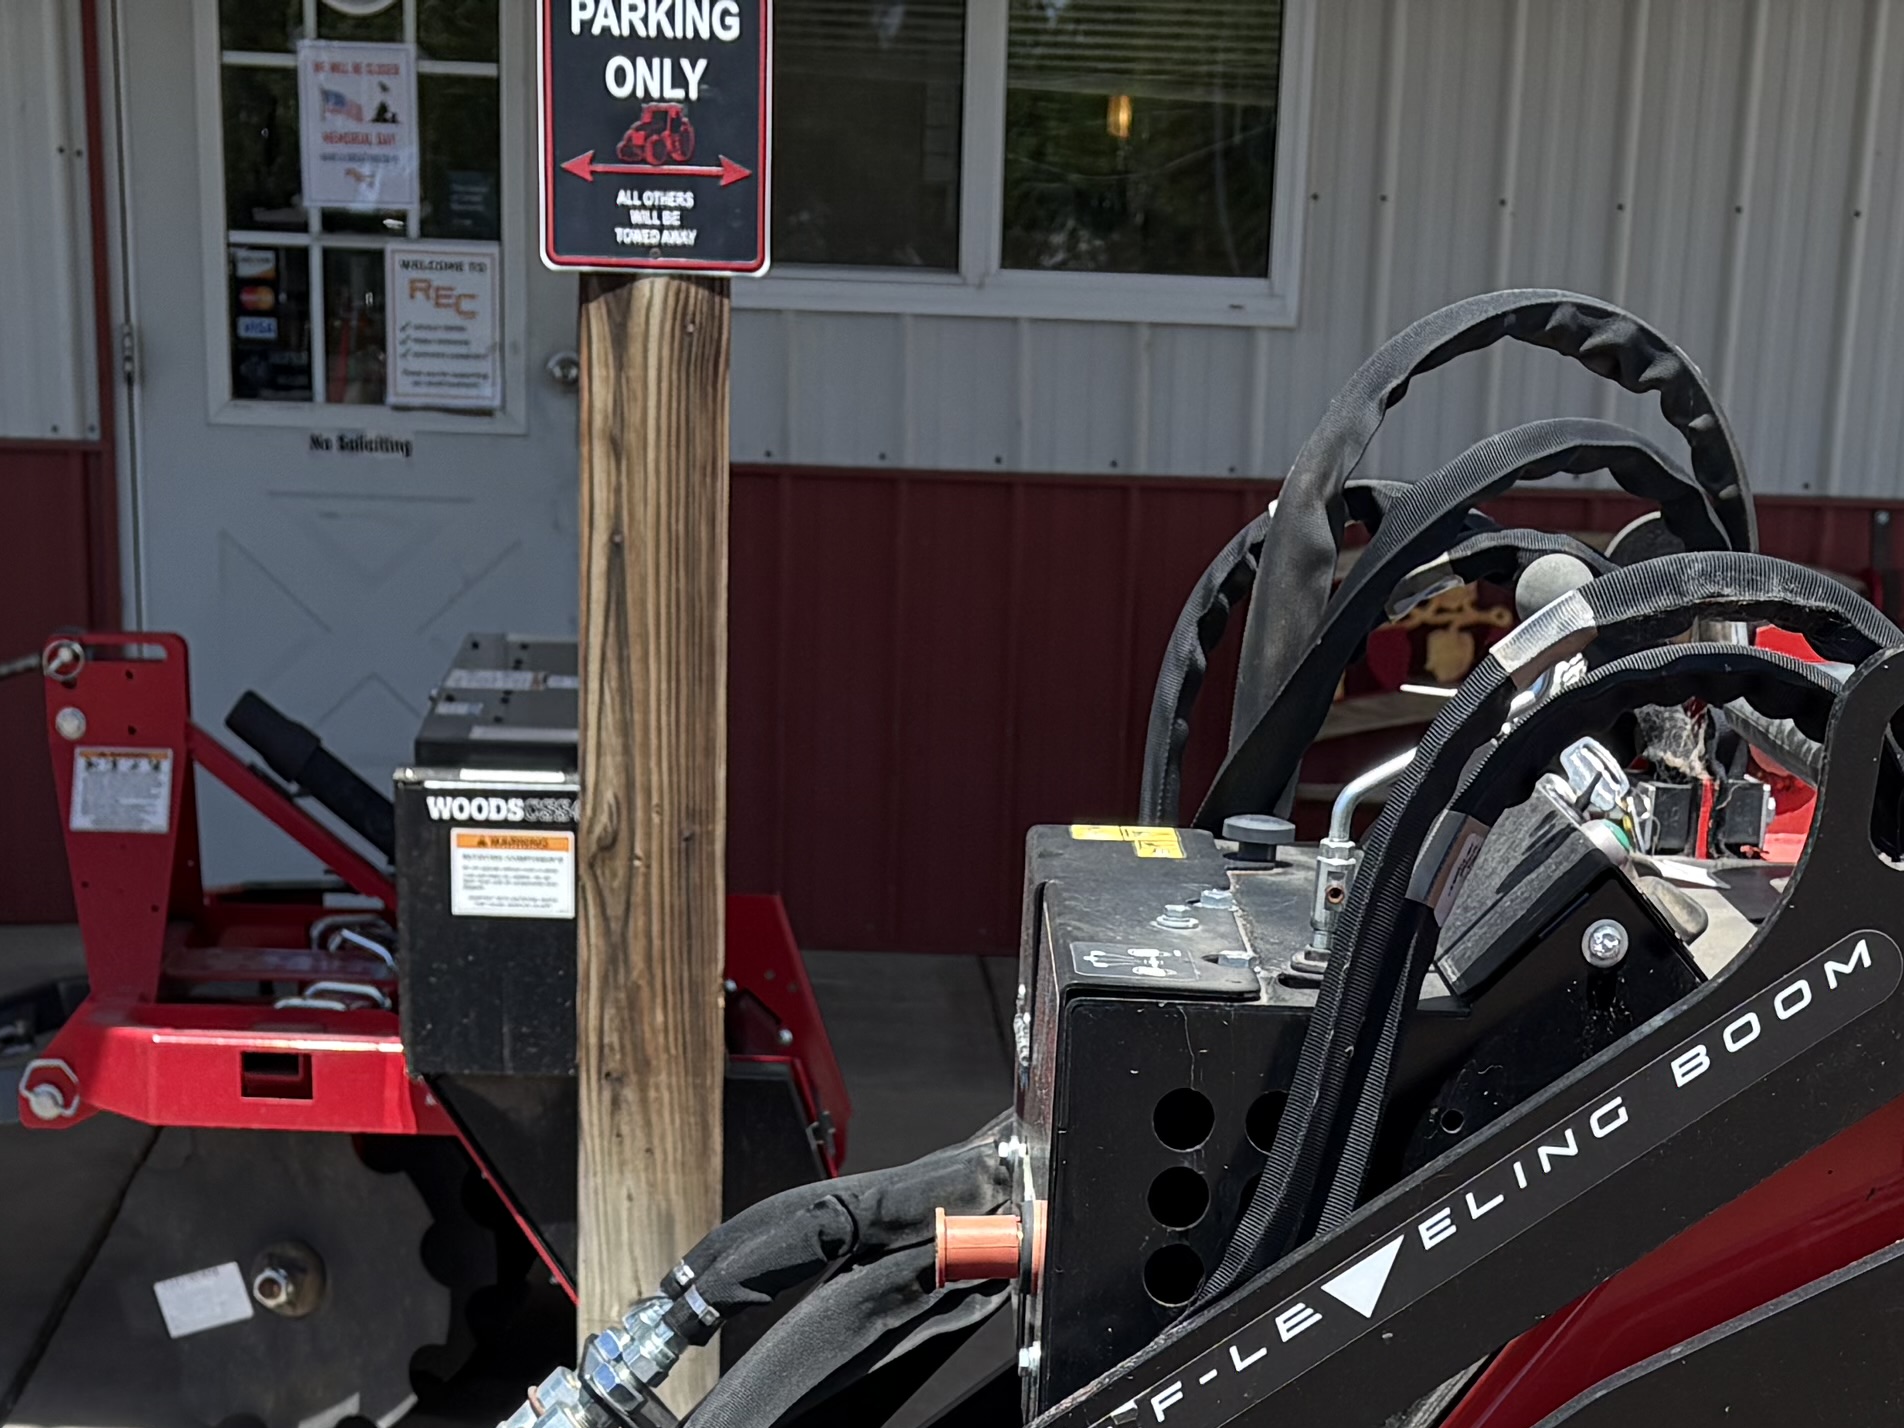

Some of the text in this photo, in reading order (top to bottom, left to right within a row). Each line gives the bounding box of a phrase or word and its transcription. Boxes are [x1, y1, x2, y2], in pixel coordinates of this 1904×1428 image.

[570, 0, 741, 41] PARKING
[605, 55, 708, 101] ONLY
[616, 189, 695, 209] ALL OTHERS
[629, 209, 681, 226] WILL BE
[614, 227, 697, 246] TOWED AWAY
[408, 277, 480, 321] REC
[309, 434, 333, 451] No
[426, 796, 524, 822] WOODS
[1671, 936, 1875, 1089] BOOM
